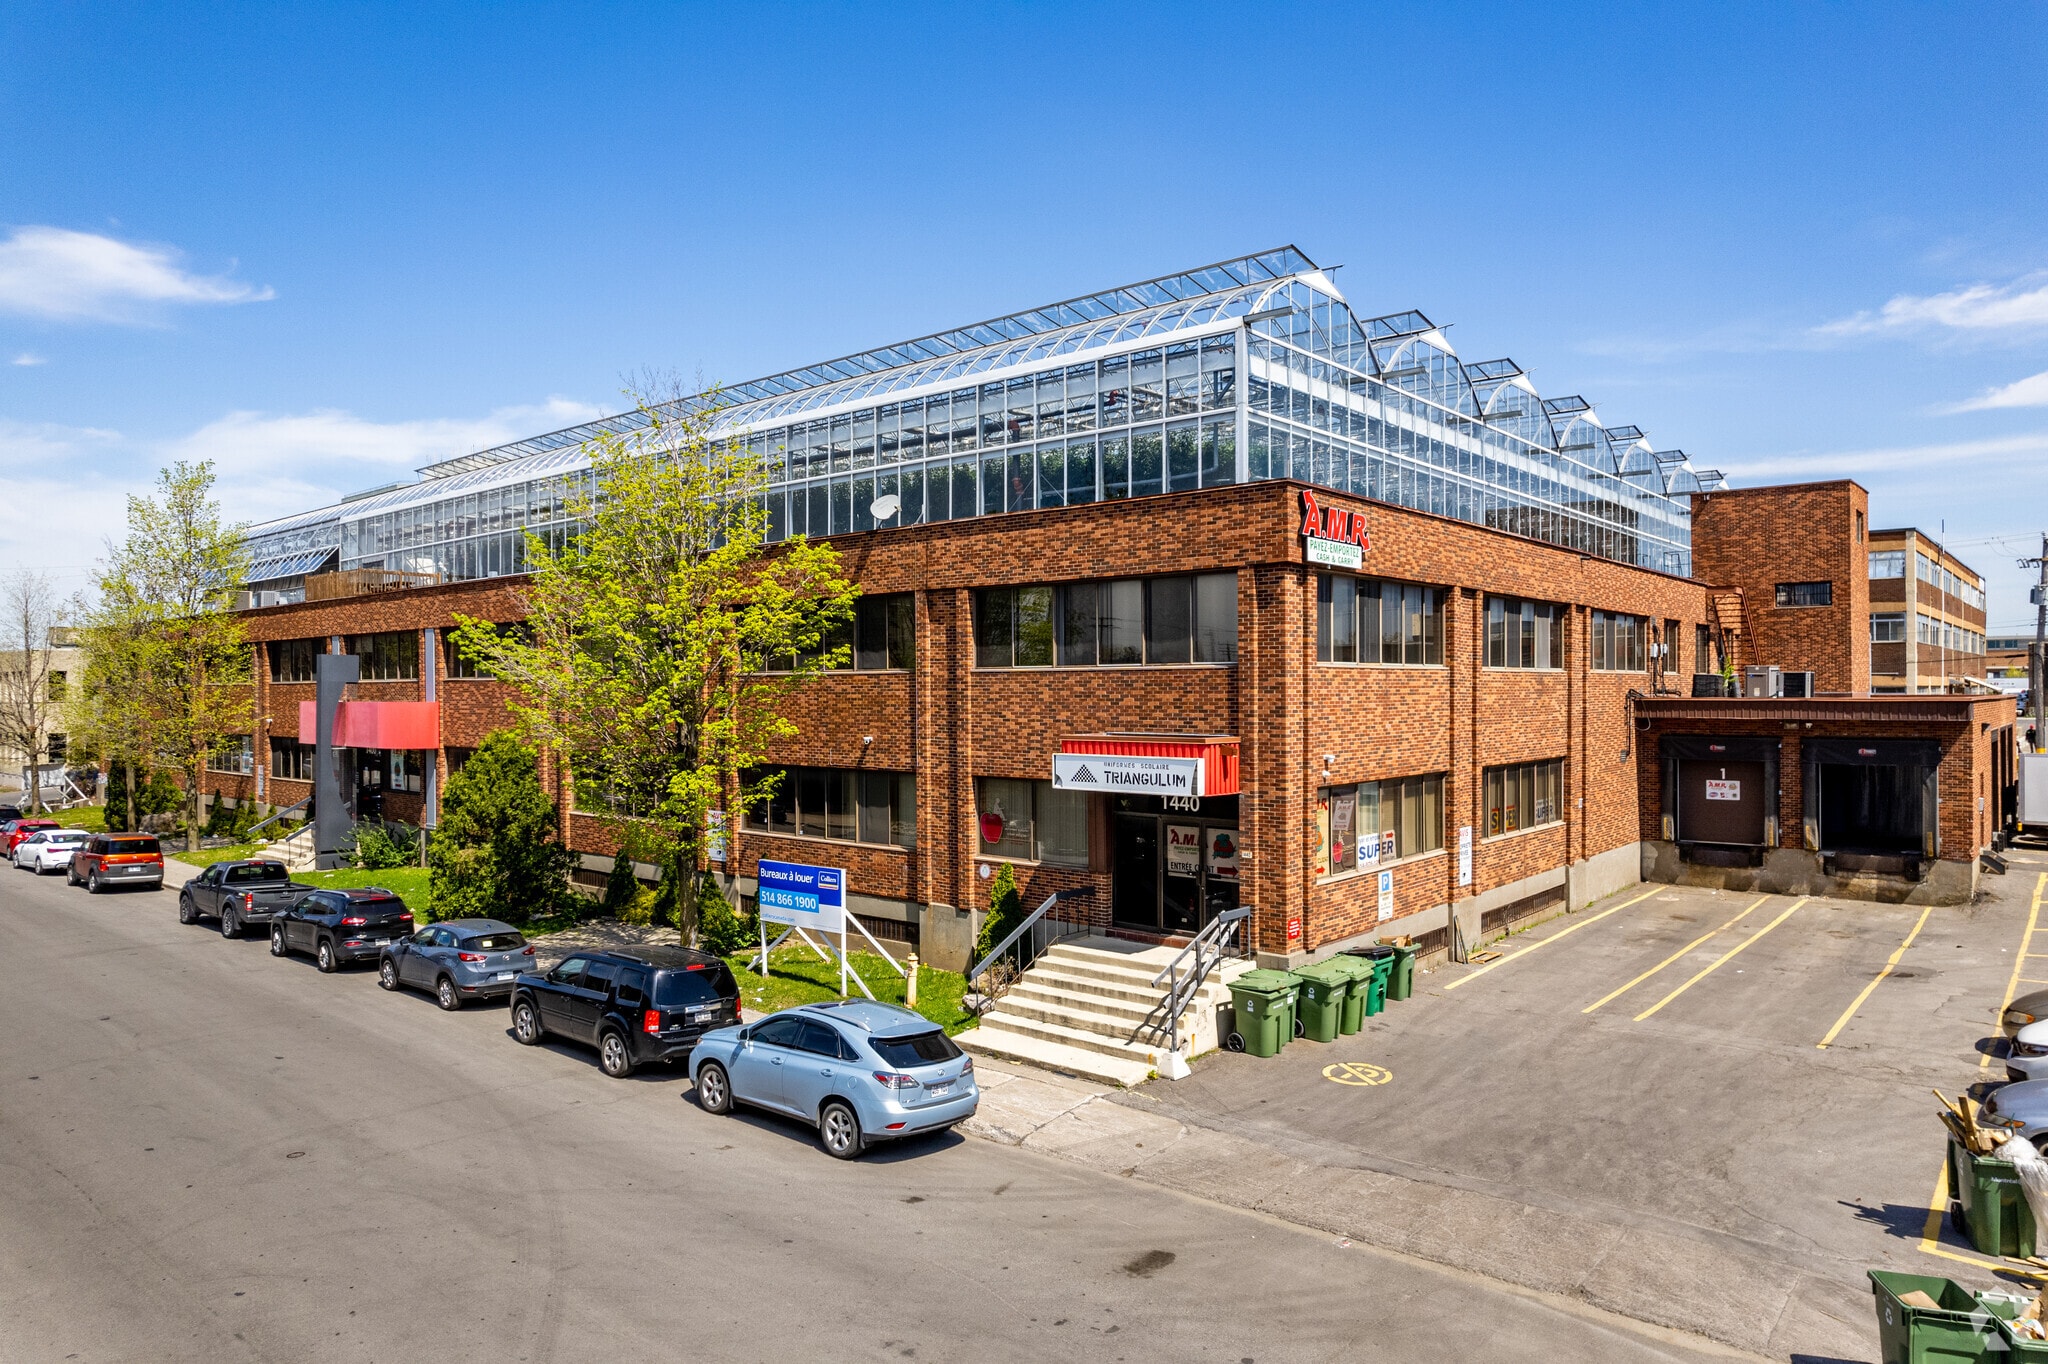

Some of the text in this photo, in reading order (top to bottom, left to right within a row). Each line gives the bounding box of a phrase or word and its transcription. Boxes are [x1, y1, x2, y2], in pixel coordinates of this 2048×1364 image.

[1302, 489, 1371, 552] A.M.R
[1316, 552, 1330, 561] CASH
[1338, 556, 1354, 565] CARRY
[1104, 761, 1136, 769] UNIFORMES
[1720, 767, 1726, 780] 1
[1104, 770, 1186, 787] TRIANGULUM
[1161, 795, 1200, 812] 1440
[1358, 840, 1394, 861] SUPER
[1170, 861, 1192, 871] ENTRÉE
[760, 867, 814, 884] Bureaux à louer
[761, 891, 816, 909] 514 866 1900
